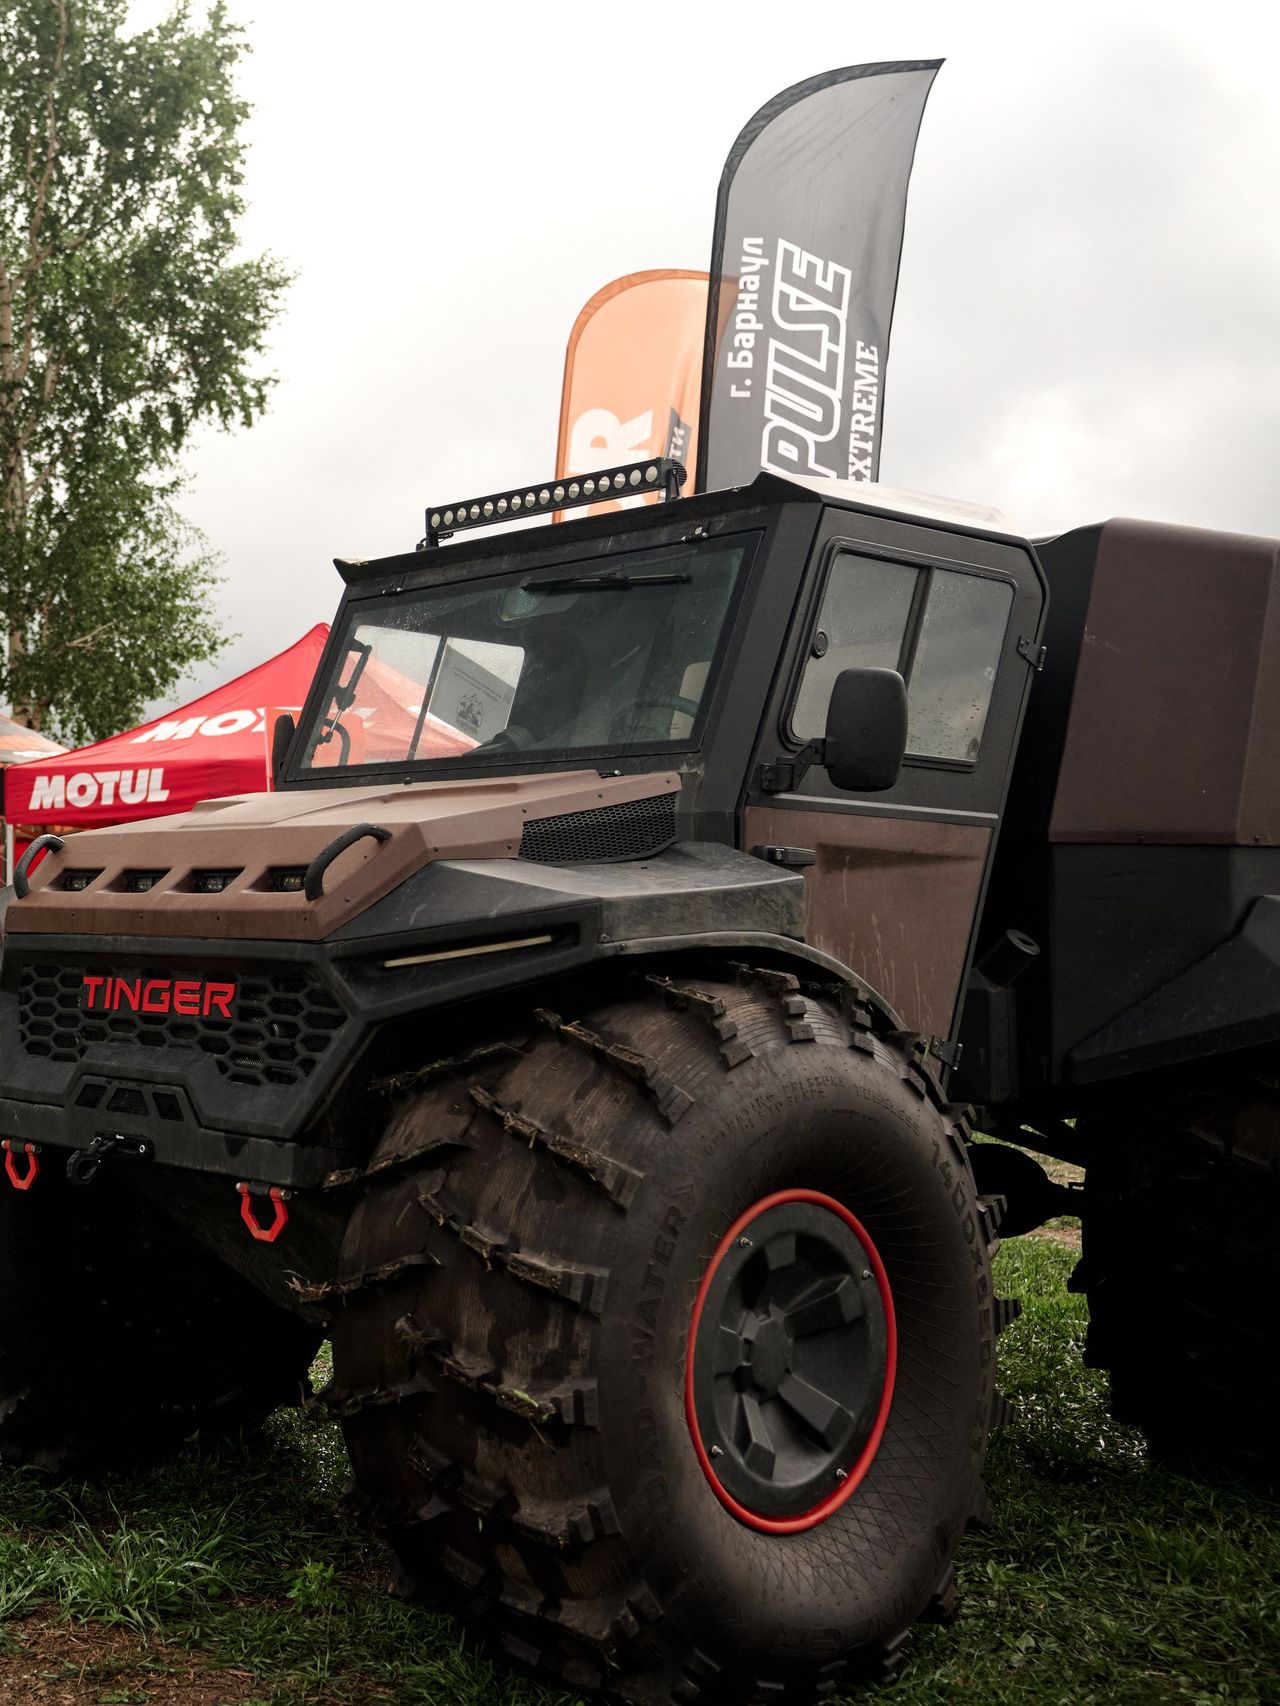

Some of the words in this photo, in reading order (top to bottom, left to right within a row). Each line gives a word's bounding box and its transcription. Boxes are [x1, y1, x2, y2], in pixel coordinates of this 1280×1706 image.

[727, 237, 770, 368] Барнаул
[761, 237, 852, 479] PULSE
[730, 378, 751, 398] г.
[28, 768, 170, 811] MOTUL
[82, 976, 236, 1018] TINGER
[853, 1084, 921, 1137] TUBELESS
